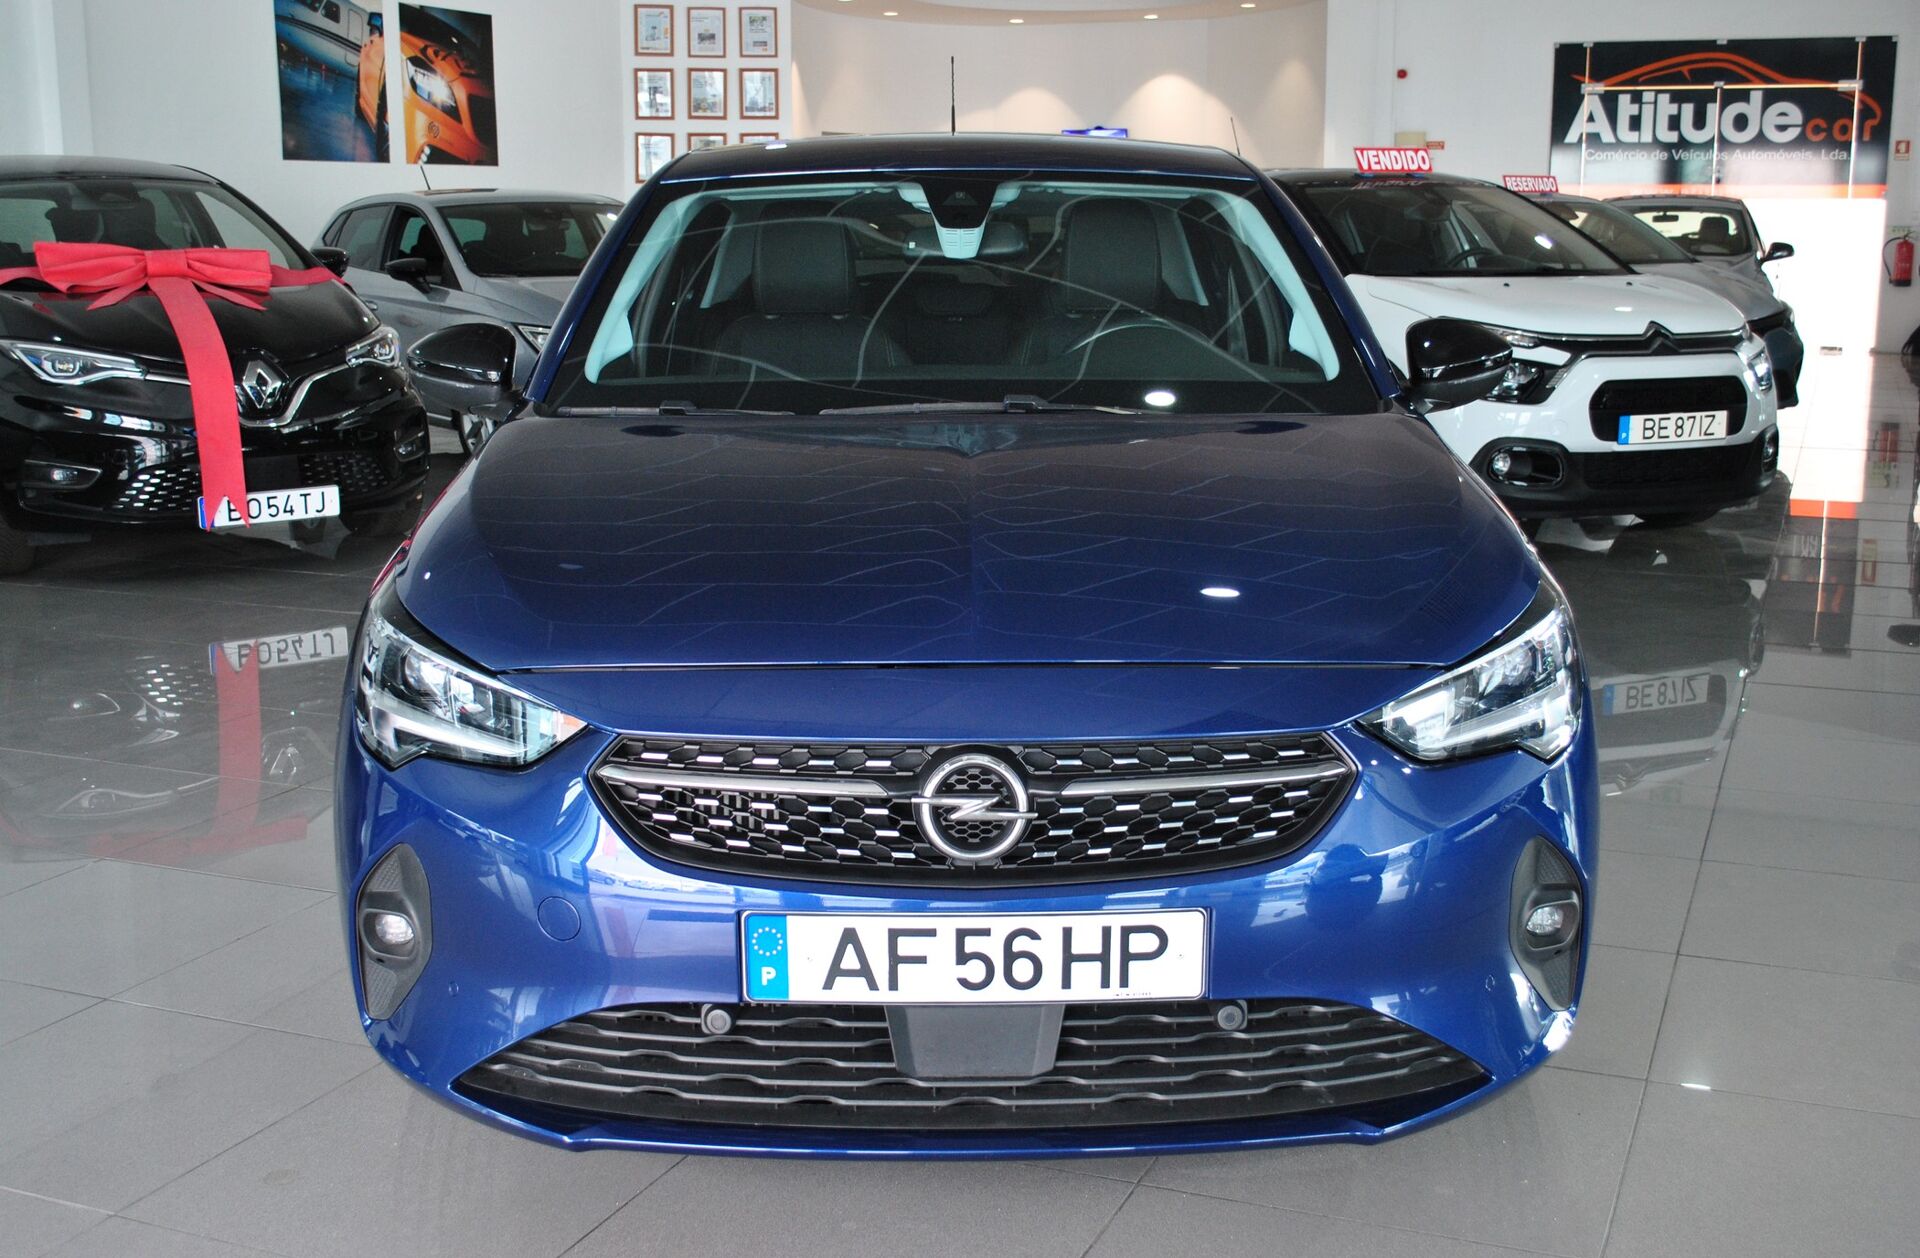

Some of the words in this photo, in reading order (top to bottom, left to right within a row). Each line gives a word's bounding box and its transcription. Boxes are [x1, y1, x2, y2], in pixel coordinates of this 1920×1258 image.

[1563, 90, 1803, 144] Atitude
[1355, 149, 1431, 171] VENDIDO
[1586, 148, 1648, 161] Comércio
[1650, 149, 1668, 161] de
[1821, 148, 1851, 161] Lda.
[1505, 176, 1557, 192] RESERVADO
[761, 966, 777, 986] P
